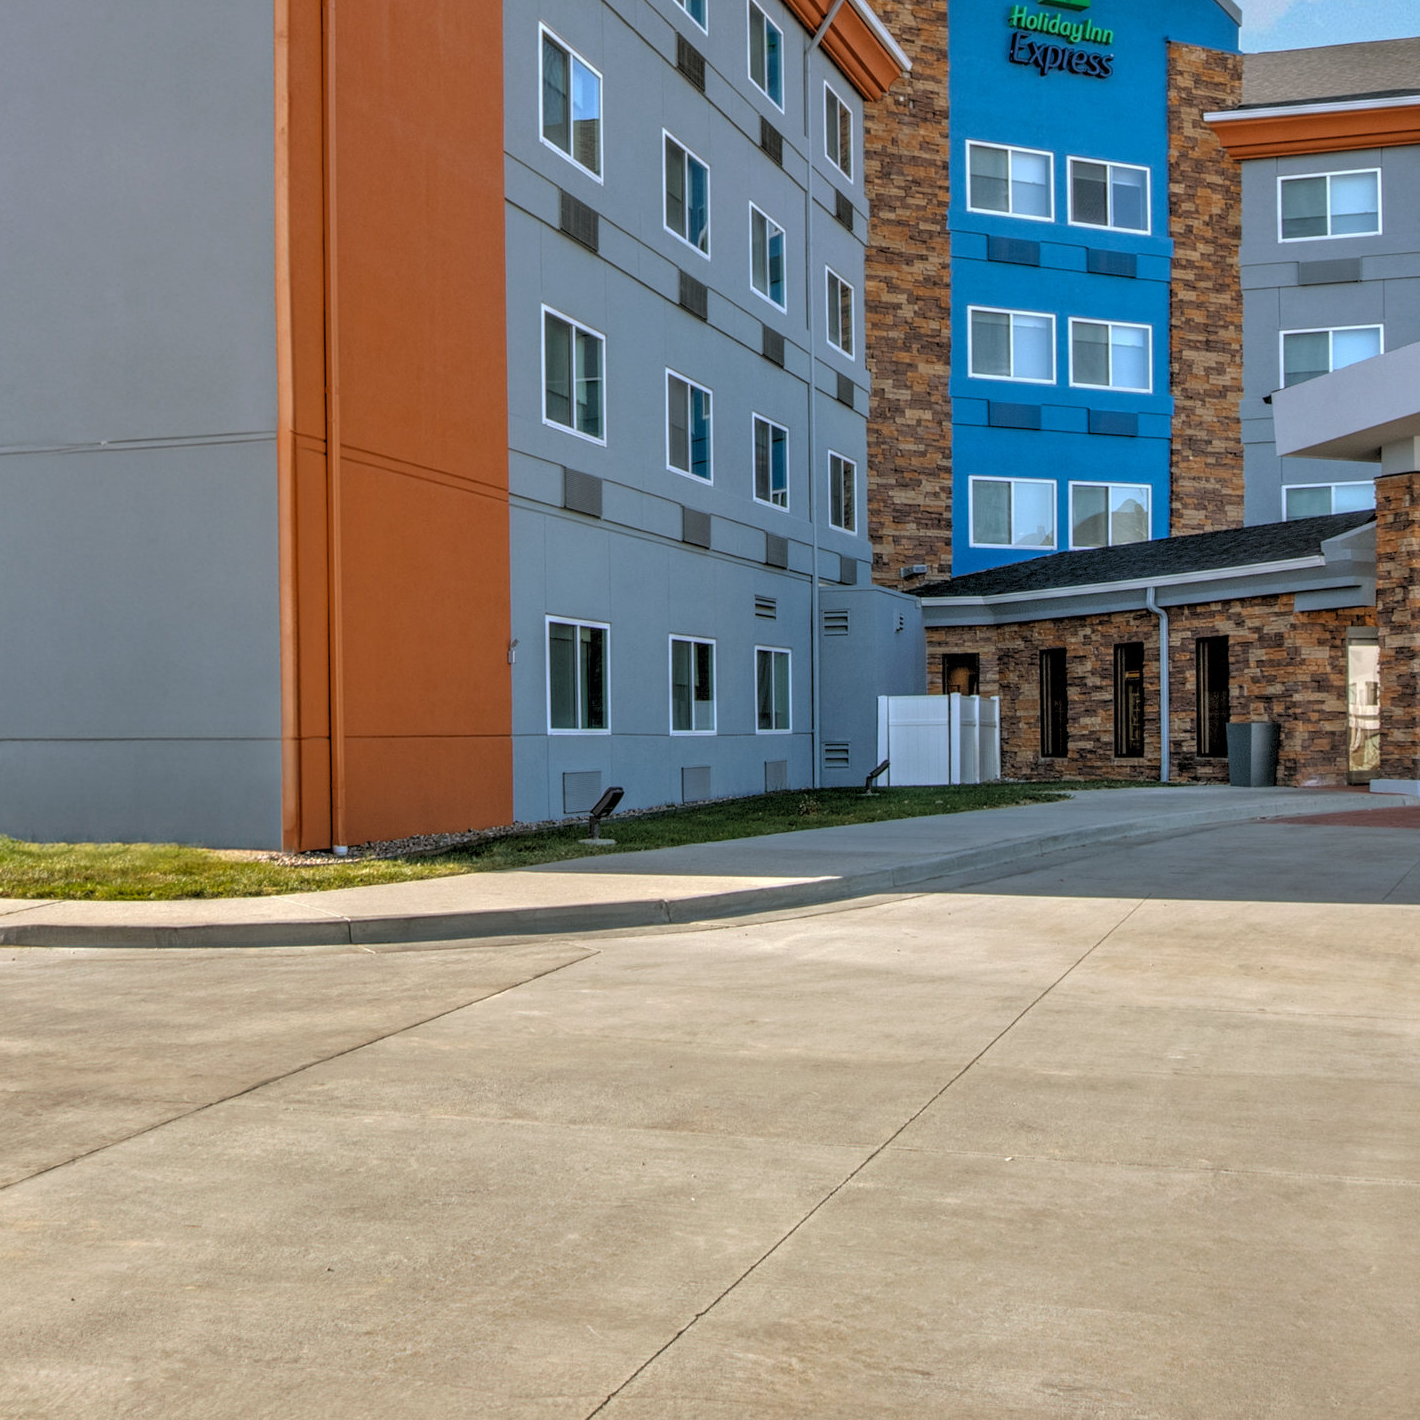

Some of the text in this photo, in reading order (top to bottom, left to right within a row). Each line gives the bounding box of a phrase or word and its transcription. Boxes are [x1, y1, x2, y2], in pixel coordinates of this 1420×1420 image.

[1009, 5, 1113, 45] Holiday Inn
[1010, 31, 1114, 79] Express
